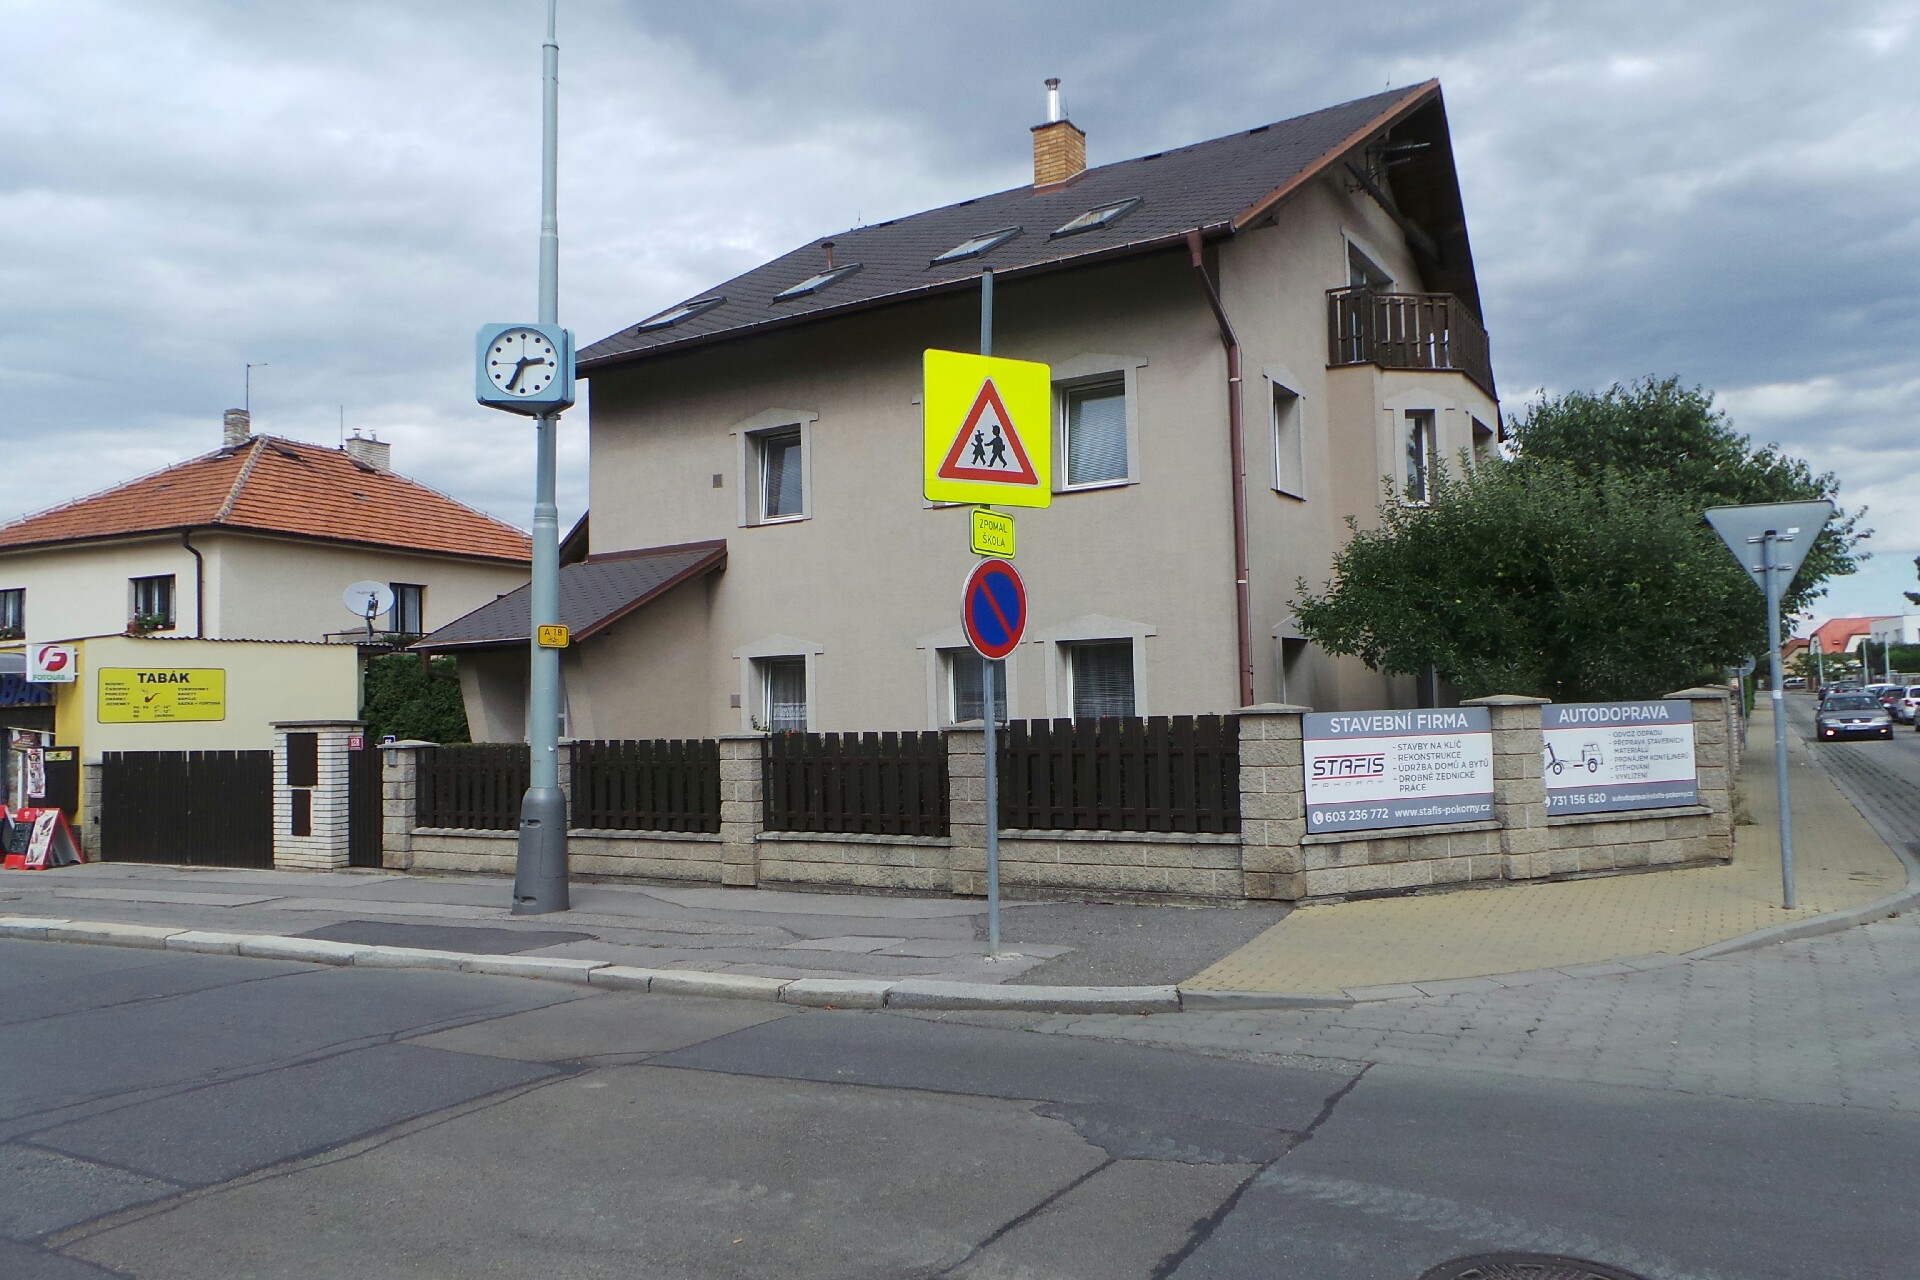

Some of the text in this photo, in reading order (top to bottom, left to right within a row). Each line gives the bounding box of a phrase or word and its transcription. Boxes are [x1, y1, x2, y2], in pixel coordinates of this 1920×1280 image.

[979, 518, 1007, 533] ZPOMAL
[982, 532, 1005, 547] ŠKOLA
[137, 670, 190, 683] TABÁK
[1559, 705, 1669, 723] AUTODOPRAVA
[1330, 712, 1468, 733] STAVEBNÍ FIRMA
[1613, 729, 1663, 738] ODVOZ ODPADU
[1397, 742, 1428, 751] STAVBY
[1398, 752, 1461, 761] REKONSTRUKCE
[1313, 758, 1384, 776] STAFIS
[1461, 761, 1467, 769] A
[1399, 772, 1433, 783] DROBNÉ
[1551, 793, 1606, 806] 731 156 620
[1325, 808, 1388, 823] 603 236 772
[1395, 804, 1490, 818] www.stafis-pokorny.cz
